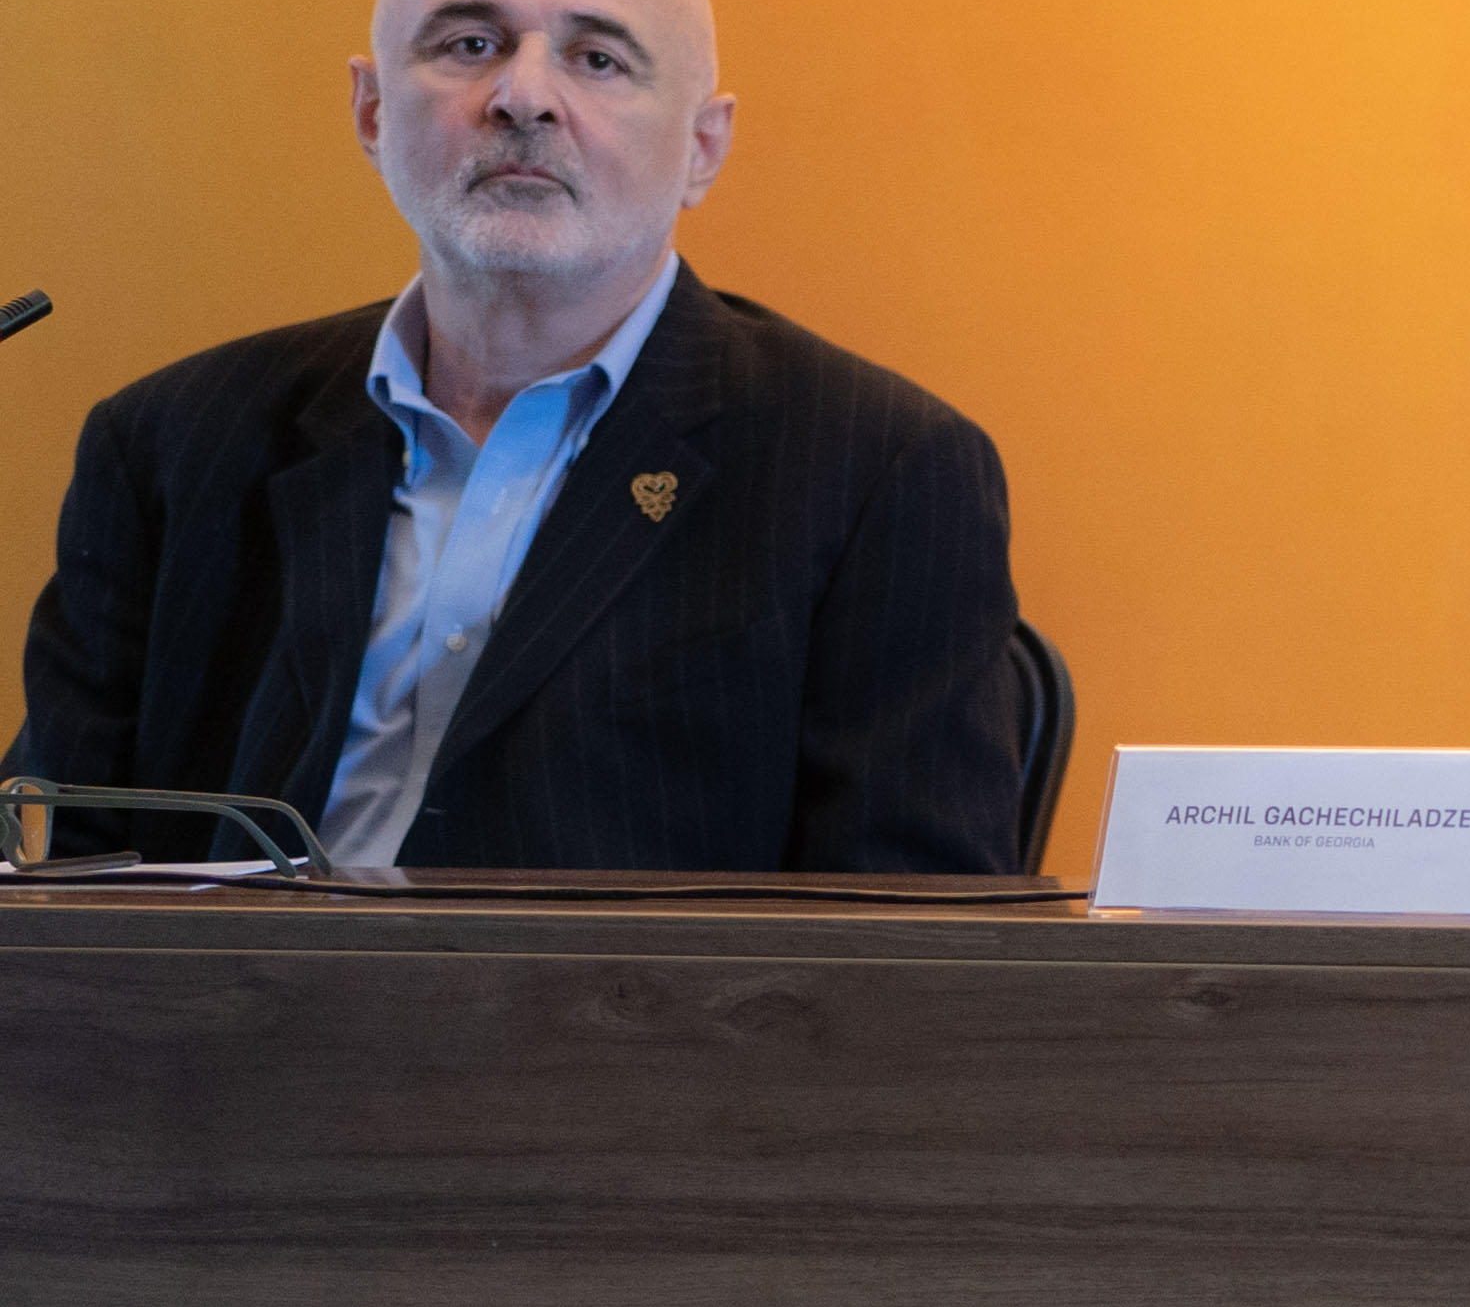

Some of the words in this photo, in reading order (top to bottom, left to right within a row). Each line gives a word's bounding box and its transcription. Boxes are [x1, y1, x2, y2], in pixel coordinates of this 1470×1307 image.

[1165, 804, 1256, 826] ARCHIL
[1253, 835, 1291, 847] BANK
[1294, 835, 1313, 848] OF
[1315, 835, 1376, 849] GEORGIA
